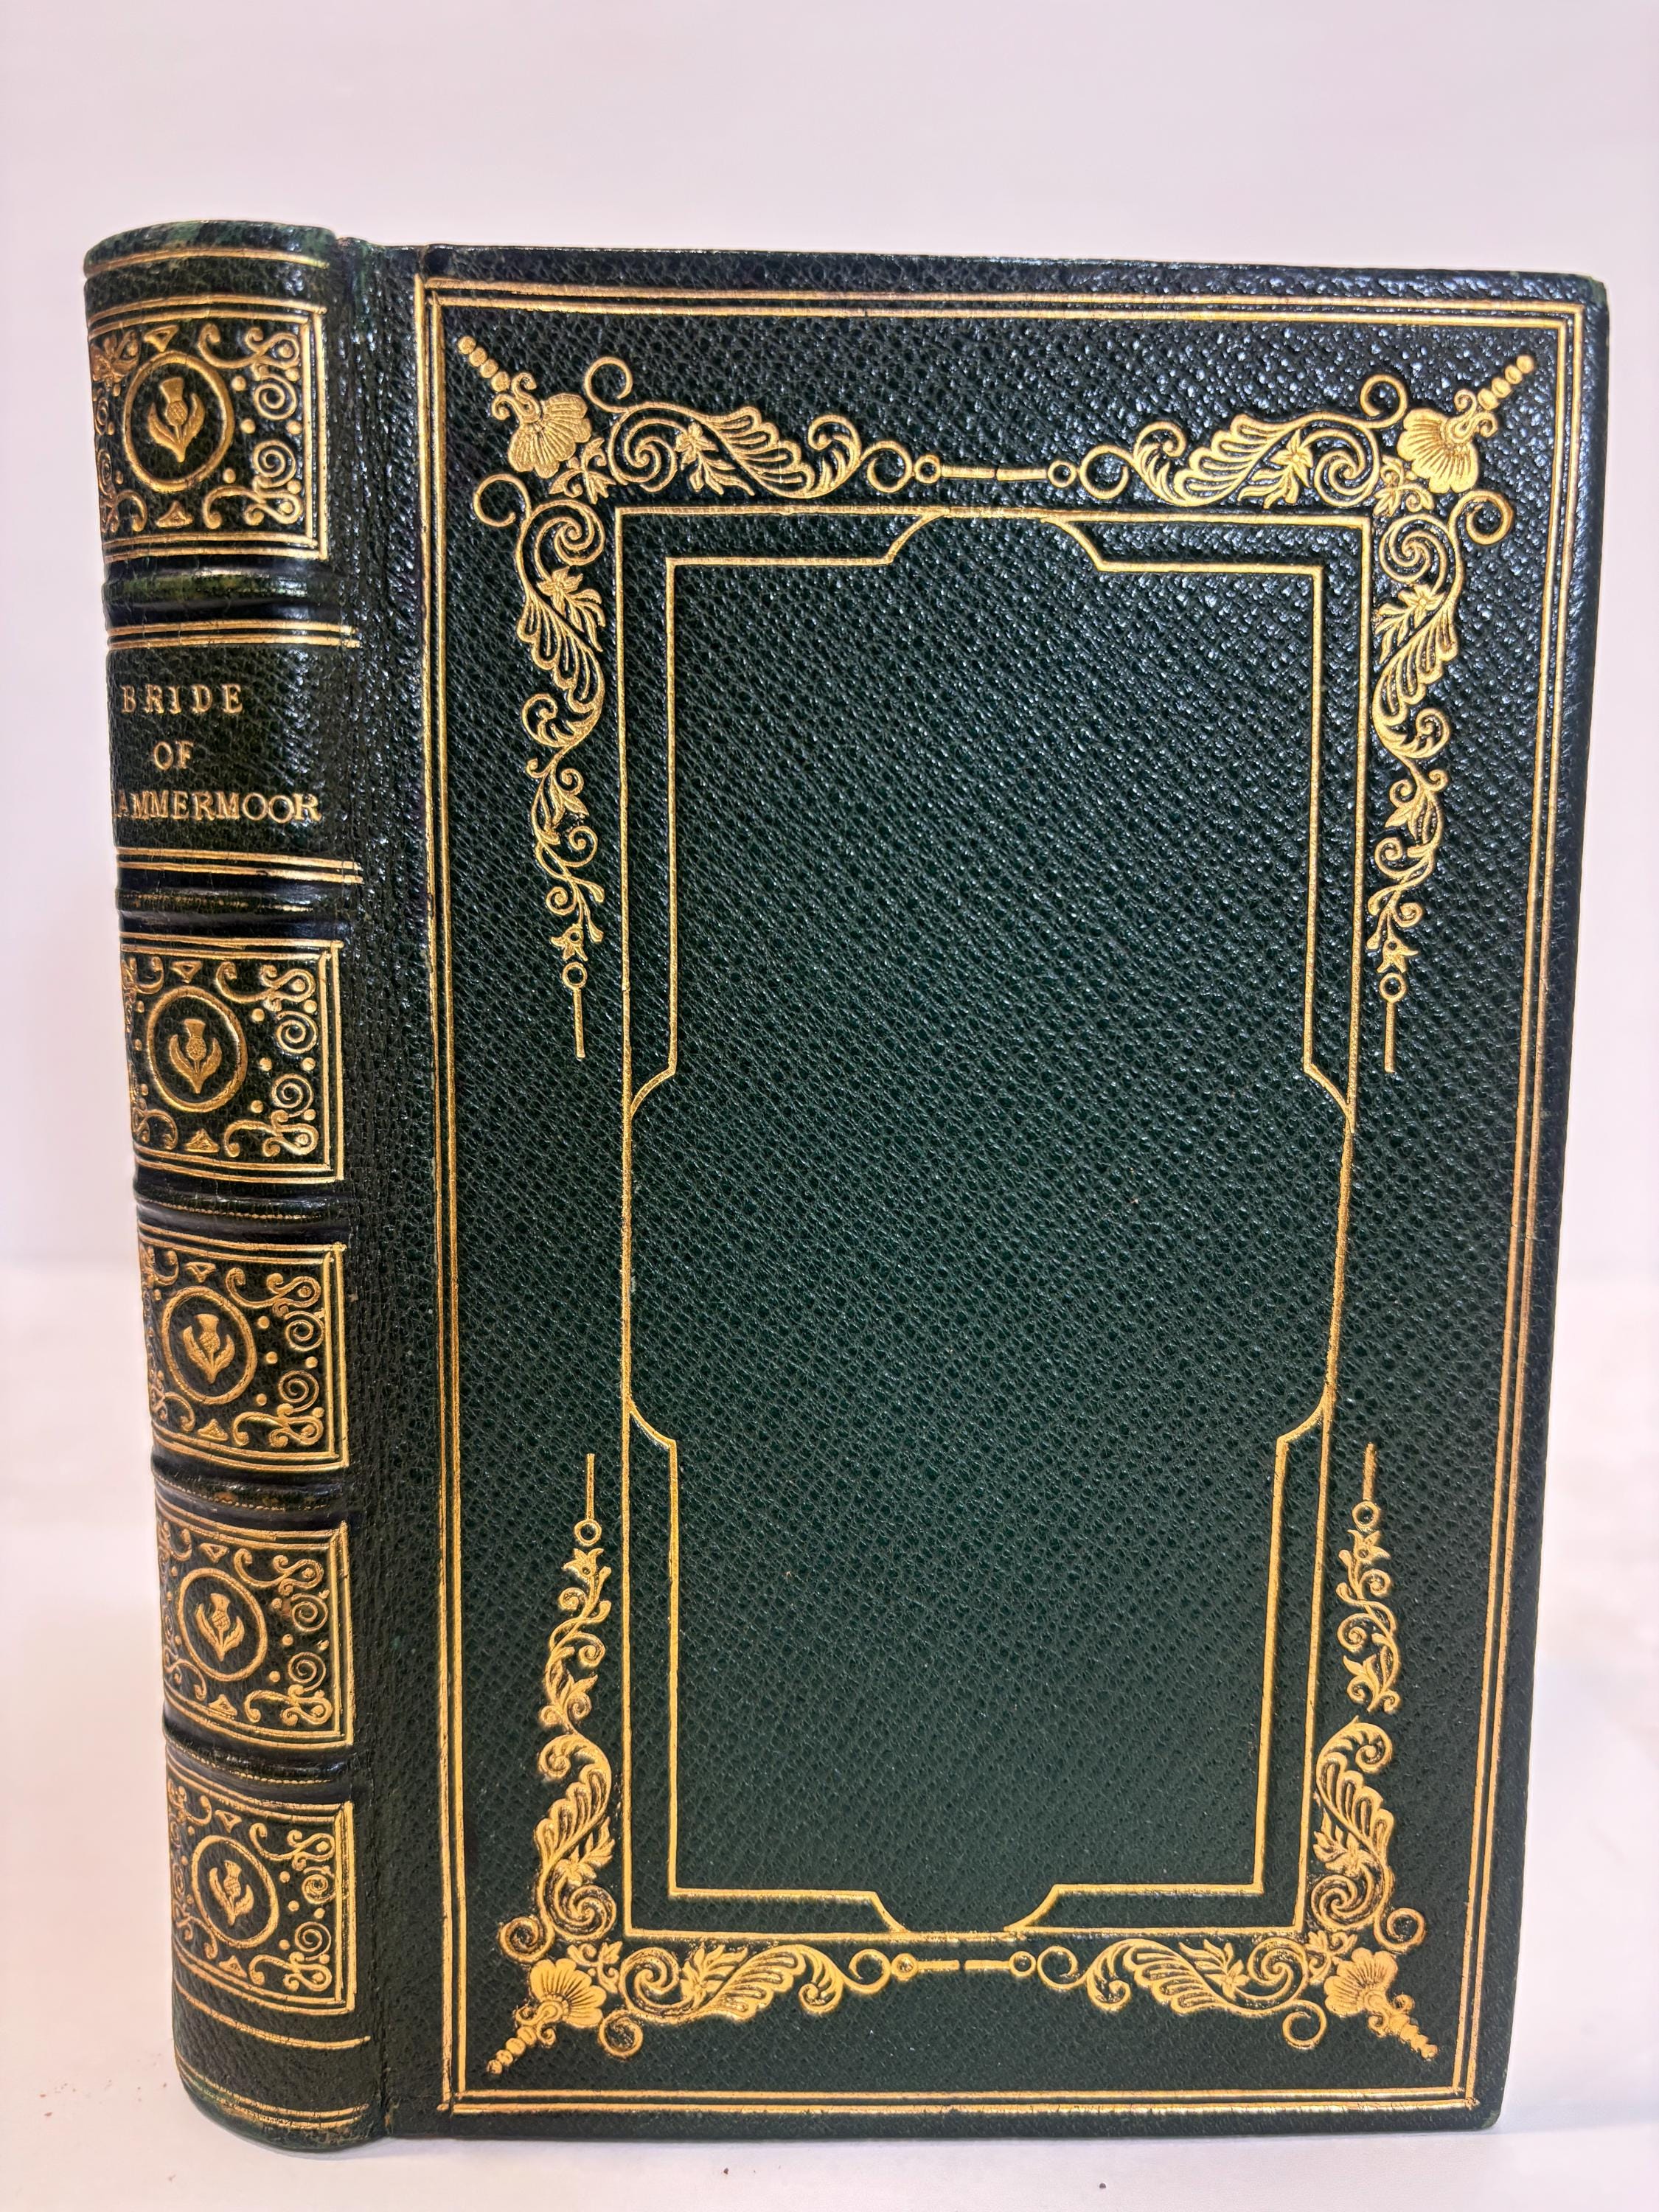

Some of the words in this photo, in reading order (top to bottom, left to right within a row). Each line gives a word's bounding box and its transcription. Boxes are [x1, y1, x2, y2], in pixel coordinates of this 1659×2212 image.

[121, 684, 243, 714] BRIDE
[153, 740, 195, 771] OF
[113, 790, 321, 824] AMMERMOOR
